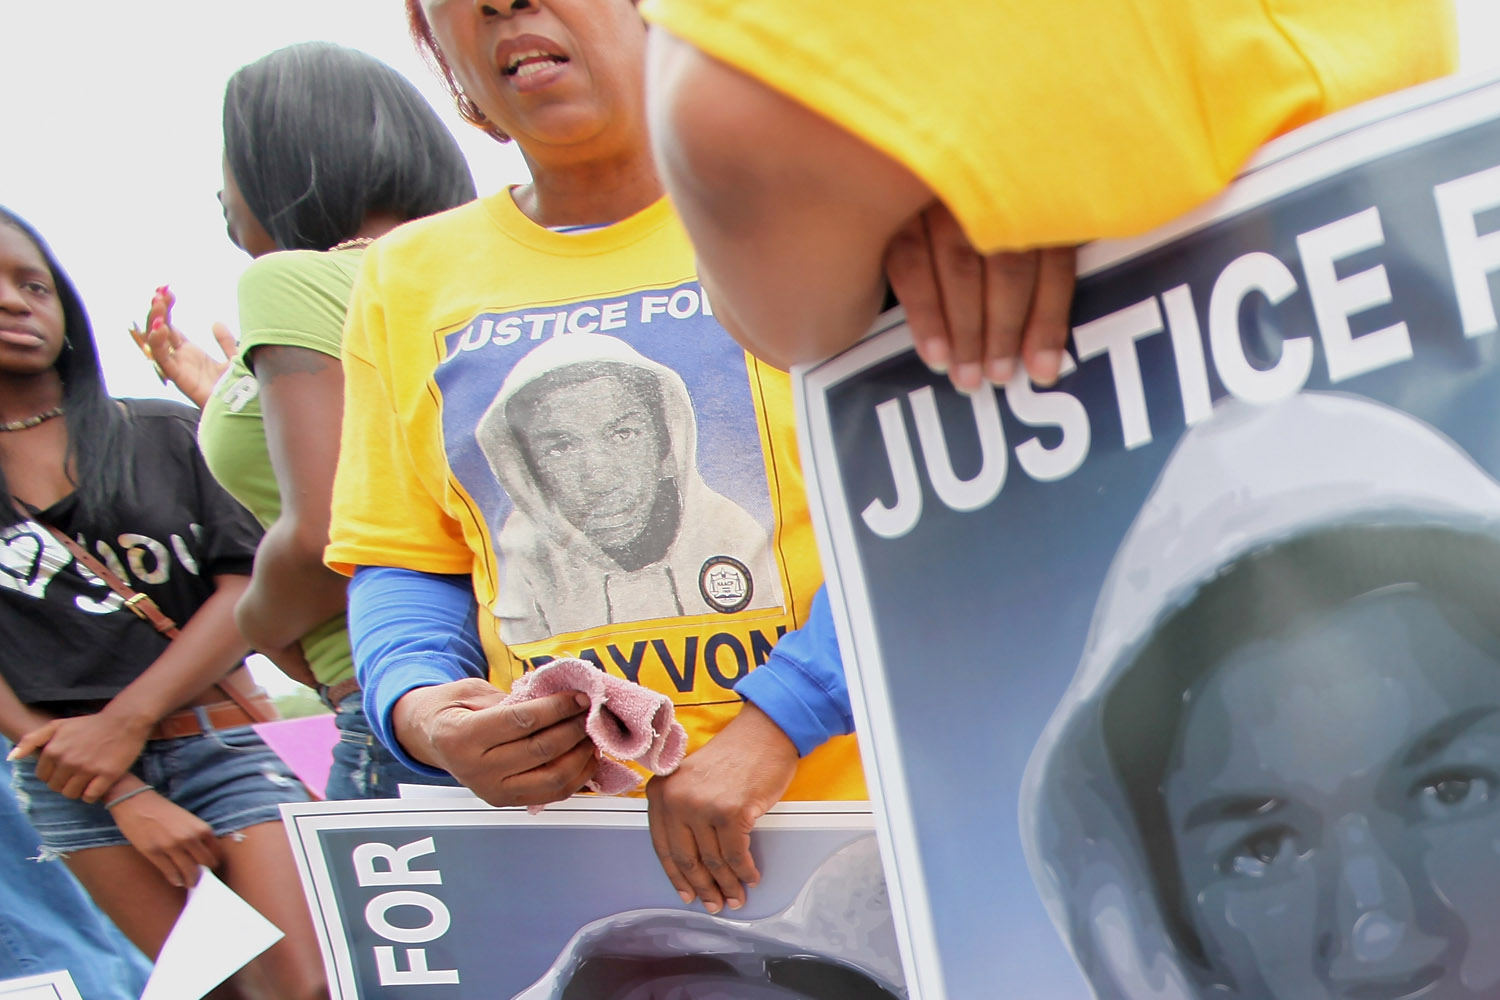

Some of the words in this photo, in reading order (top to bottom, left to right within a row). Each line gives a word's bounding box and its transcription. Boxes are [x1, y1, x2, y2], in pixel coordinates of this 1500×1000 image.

[860, 206, 1412, 539] JUSTICE
[522, 625, 787, 693] AYVON
[352, 836, 460, 986] FOR
